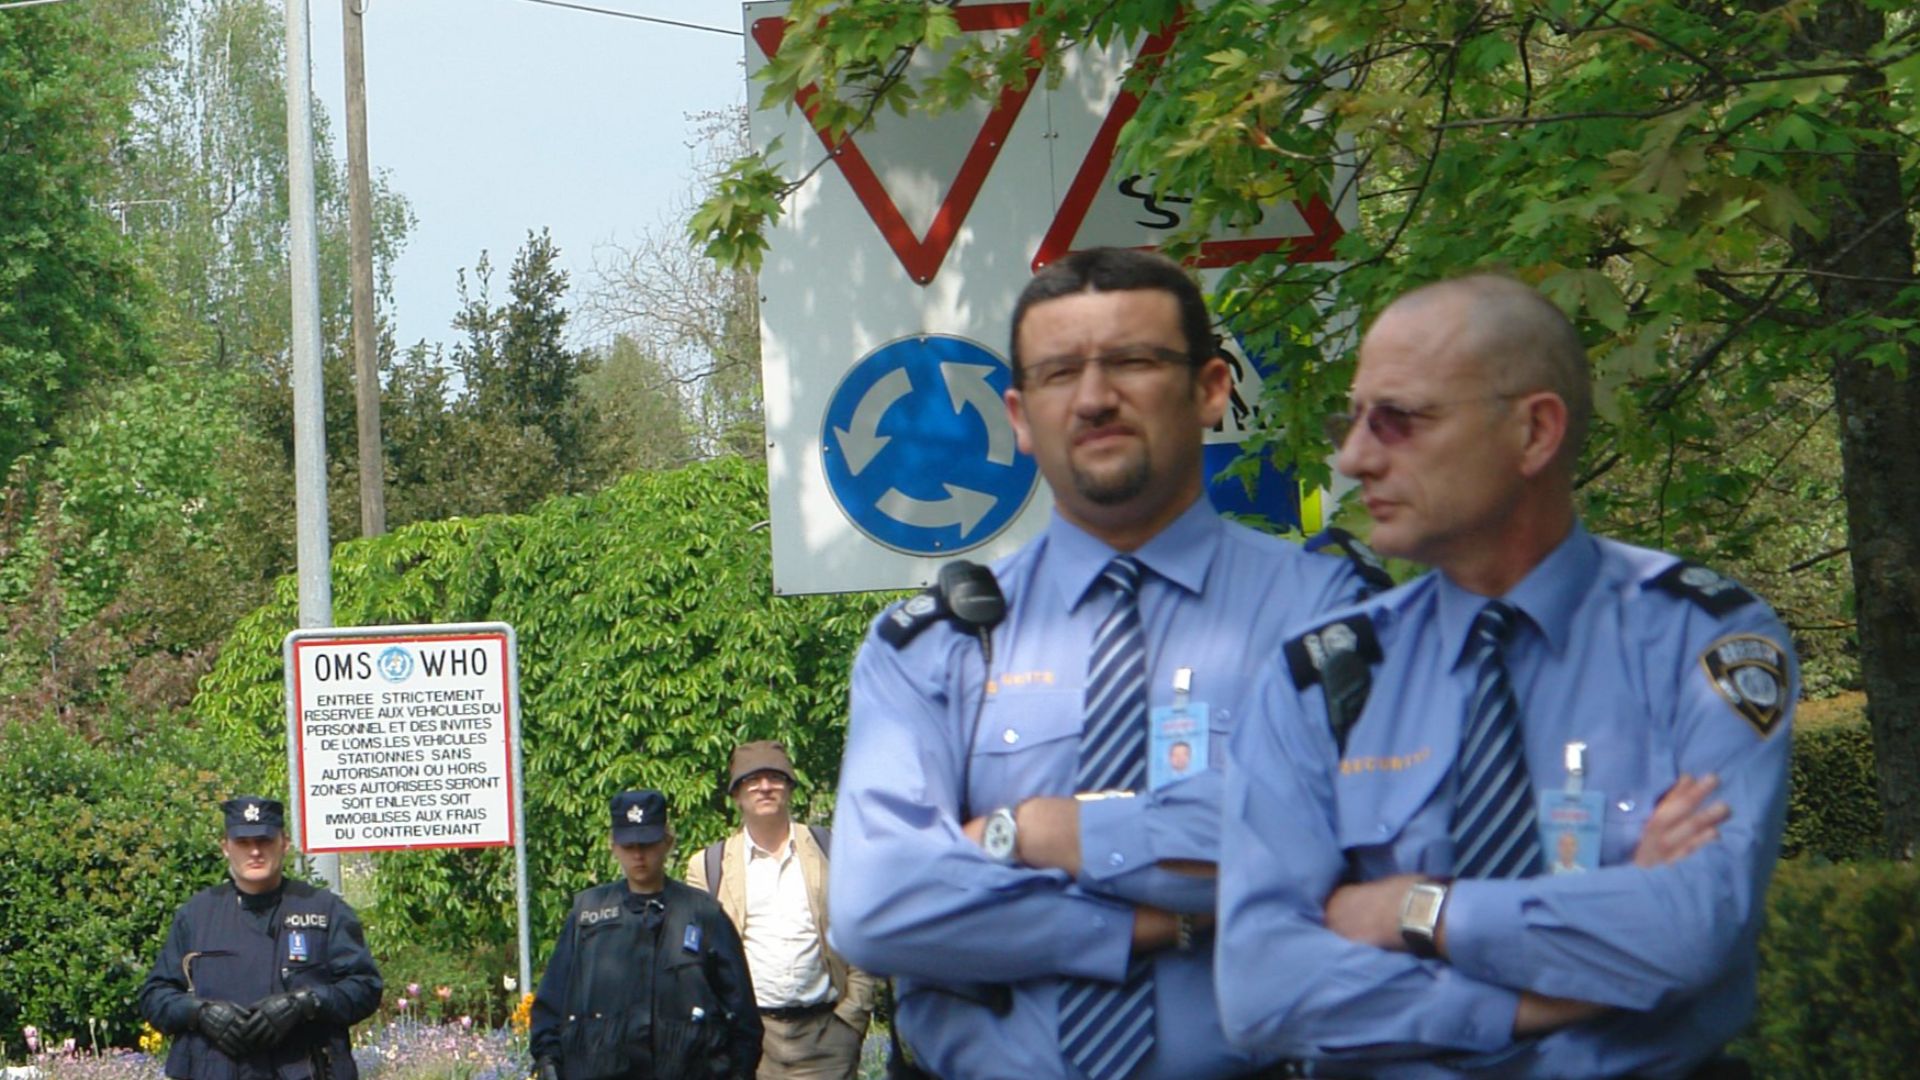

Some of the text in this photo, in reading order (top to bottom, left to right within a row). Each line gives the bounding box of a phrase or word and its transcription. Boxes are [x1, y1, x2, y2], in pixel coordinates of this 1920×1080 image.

[315, 648, 487, 681] OMS WHO
[317, 689, 485, 707] ENTREE STRICTEMENT
[304, 703, 501, 721] RESERVEE AUX VEHICULES DU
[306, 717, 492, 736] PERSONNEL ET DES INVITES
[321, 738, 338, 750] DE
[413, 733, 487, 746] VEHICULES
[337, 748, 472, 765] STATIONNES SANS
[321, 762, 487, 780] AUTORISATION OU HORS
[311, 776, 500, 796] ZONES AUTORISEES SERONT
[341, 793, 471, 809] SOIT ENLEVES SOIT
[325, 808, 487, 825] IMMOBILISES AUX FRAIS
[335, 823, 482, 840] DU CONTREVENANT
